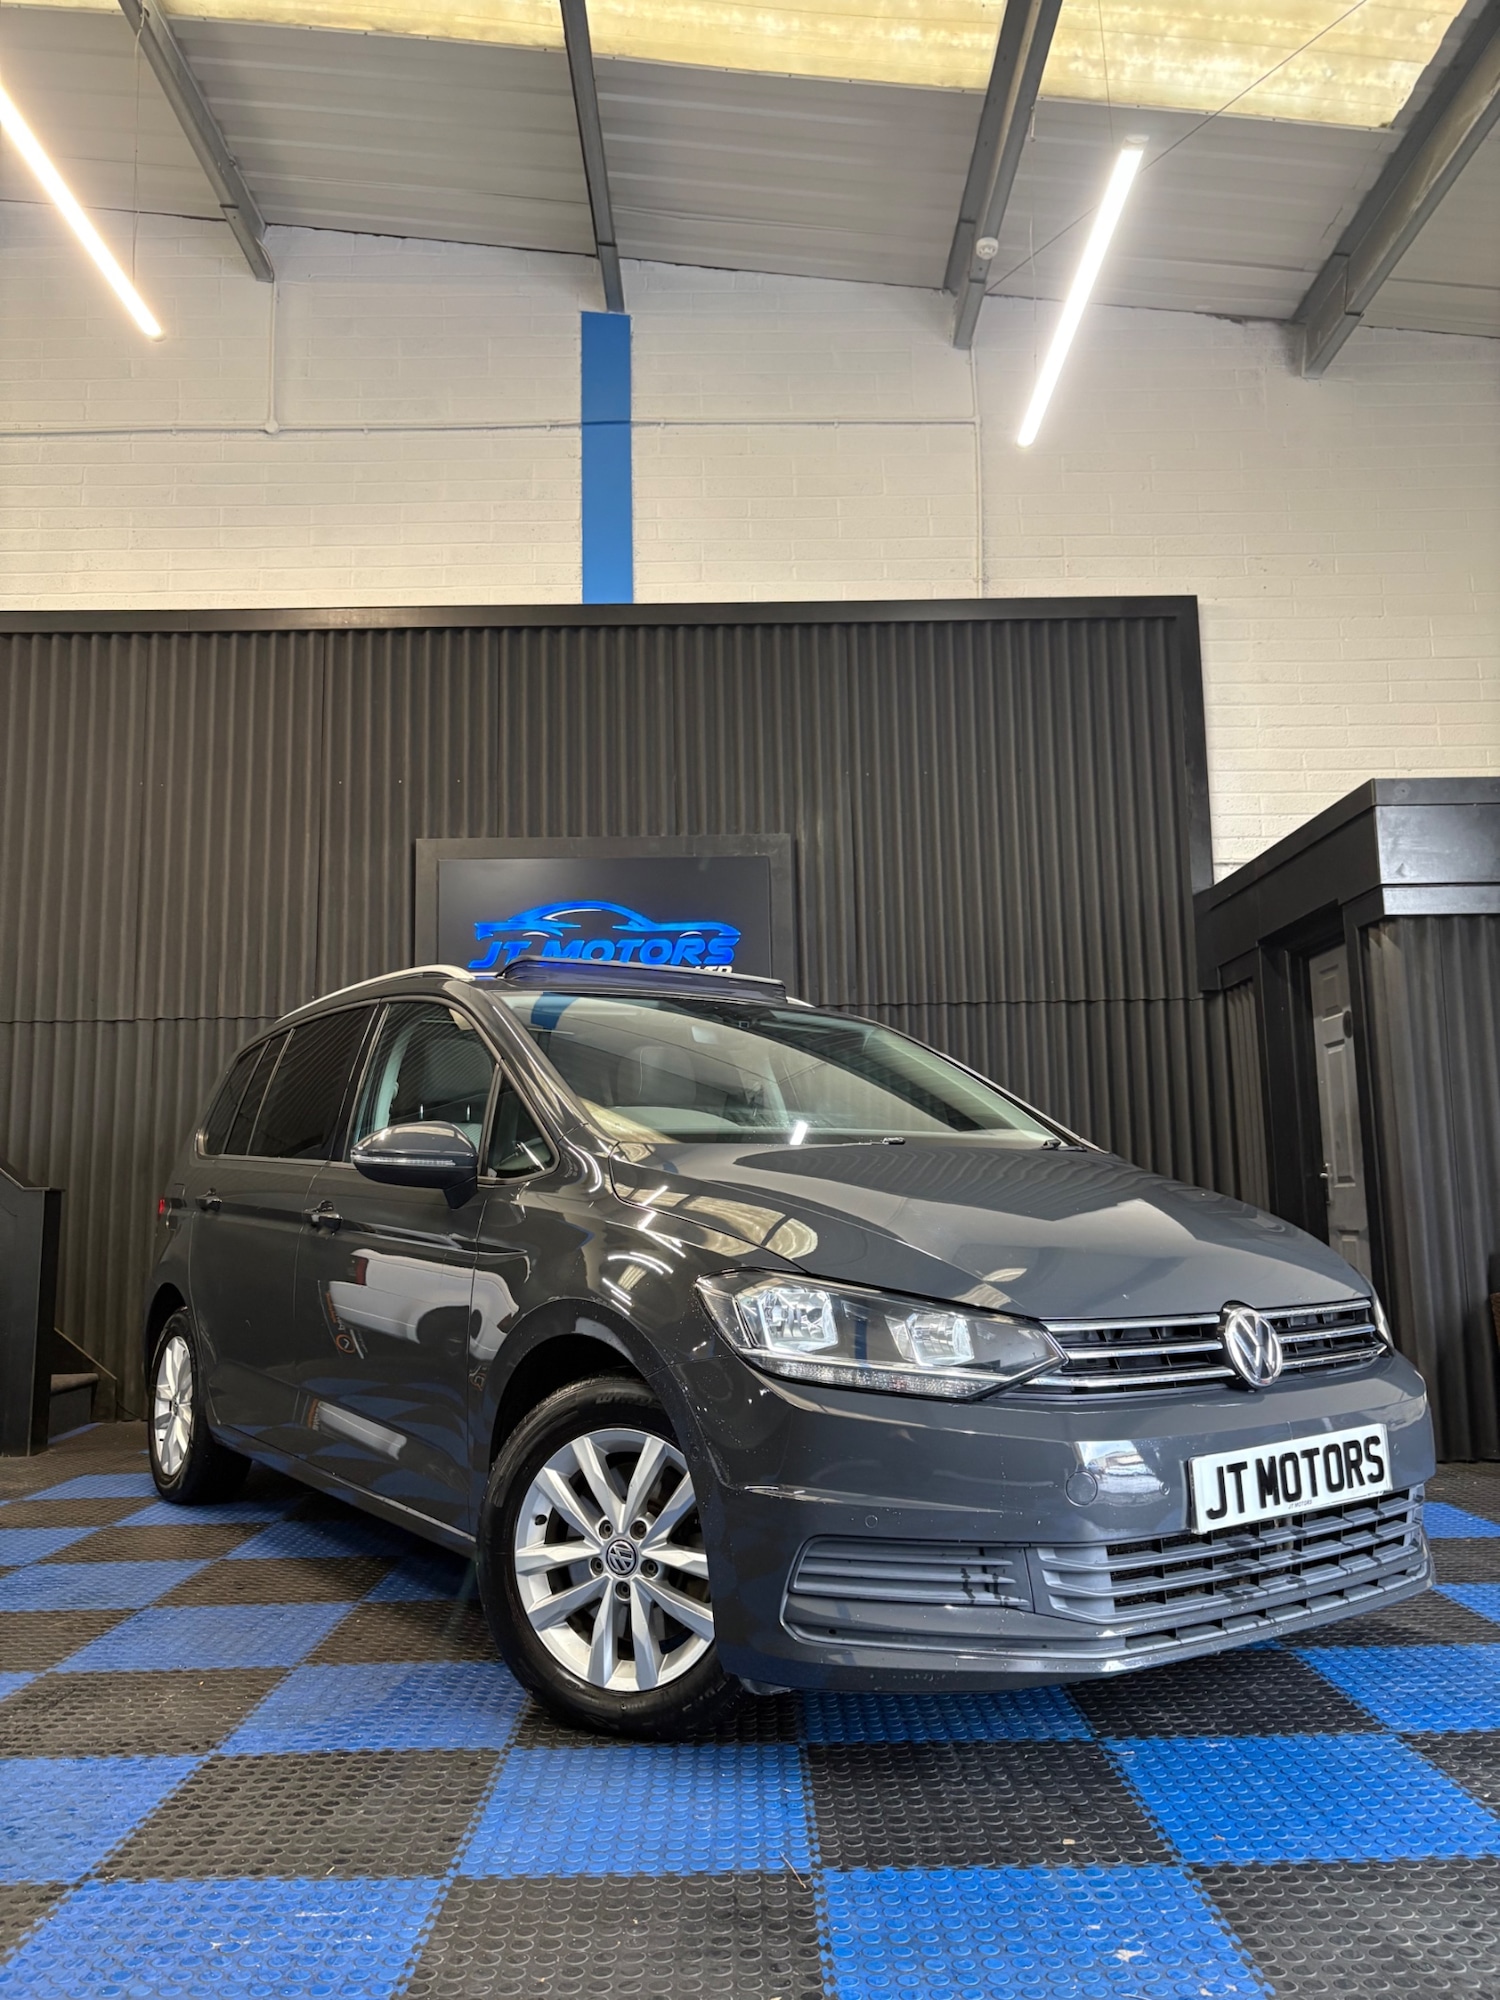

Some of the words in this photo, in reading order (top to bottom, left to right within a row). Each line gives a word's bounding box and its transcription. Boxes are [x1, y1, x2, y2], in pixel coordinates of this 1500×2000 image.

[468, 941, 532, 968] JT
[541, 937, 740, 965] MOTORS
[1206, 1461, 1248, 1520] JT
[1255, 1435, 1385, 1509] MOTORS
